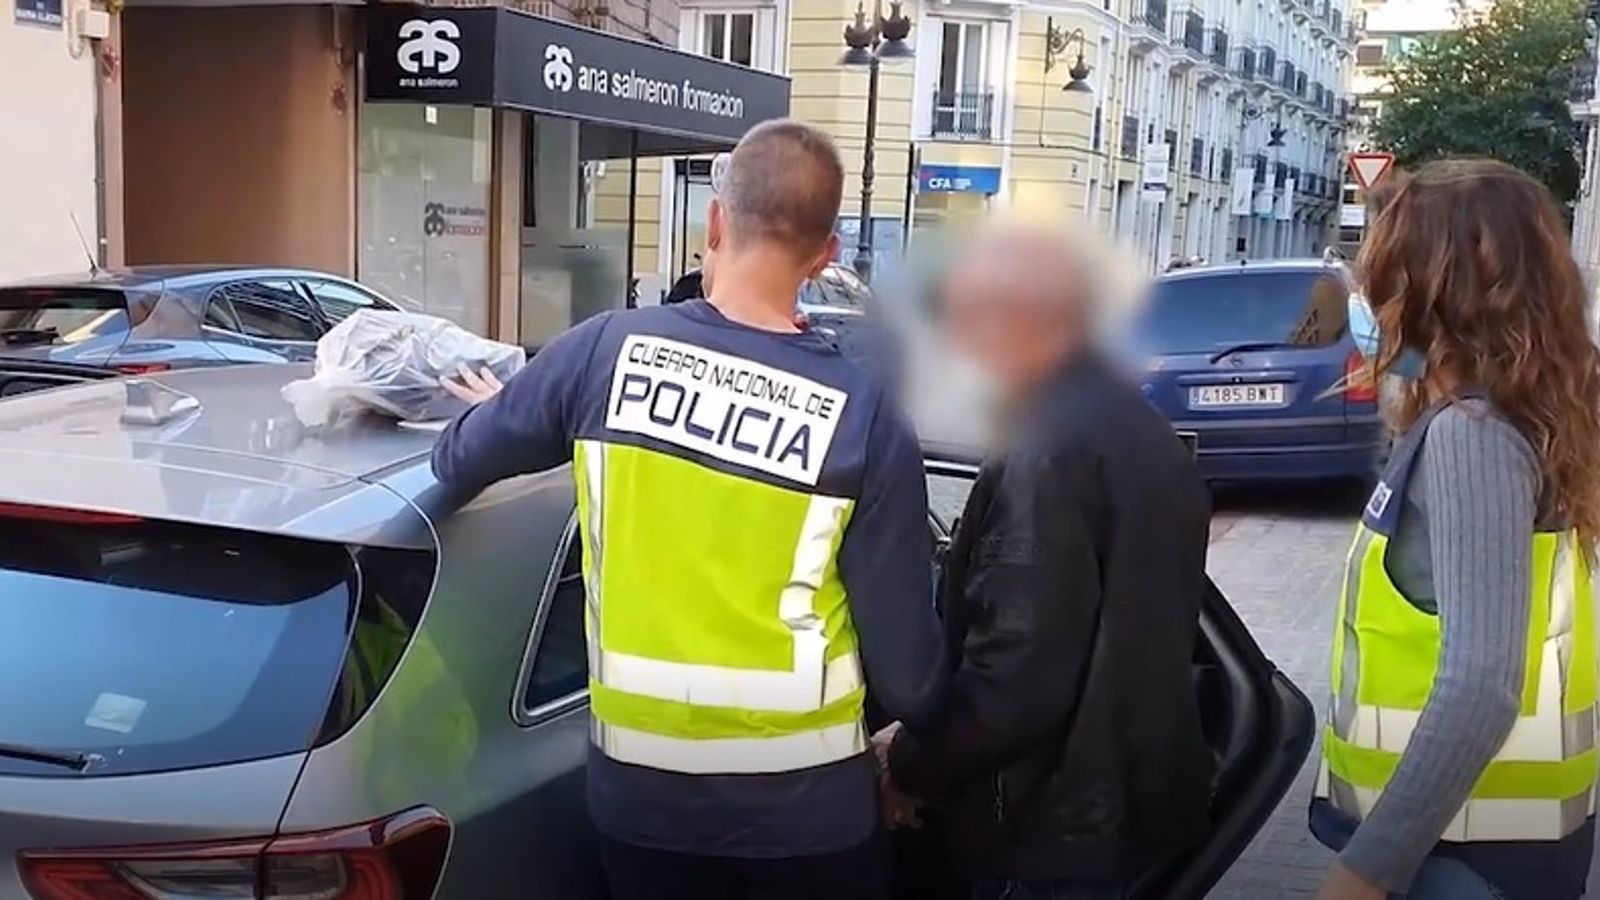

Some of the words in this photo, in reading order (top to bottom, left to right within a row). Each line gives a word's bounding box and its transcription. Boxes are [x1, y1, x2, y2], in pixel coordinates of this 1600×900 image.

[399, 78, 417, 87] ana
[578, 66, 608, 95] ana
[611, 69, 679, 106] salmeron
[682, 79, 744, 119] formacion
[928, 178, 951, 189] CFA
[628, 342, 707, 381] CUERPO
[708, 363, 799, 410] NACIONAL
[804, 392, 836, 420] DE
[1202, 387, 1242, 402] 4185
[614, 372, 811, 472] POLICIA
